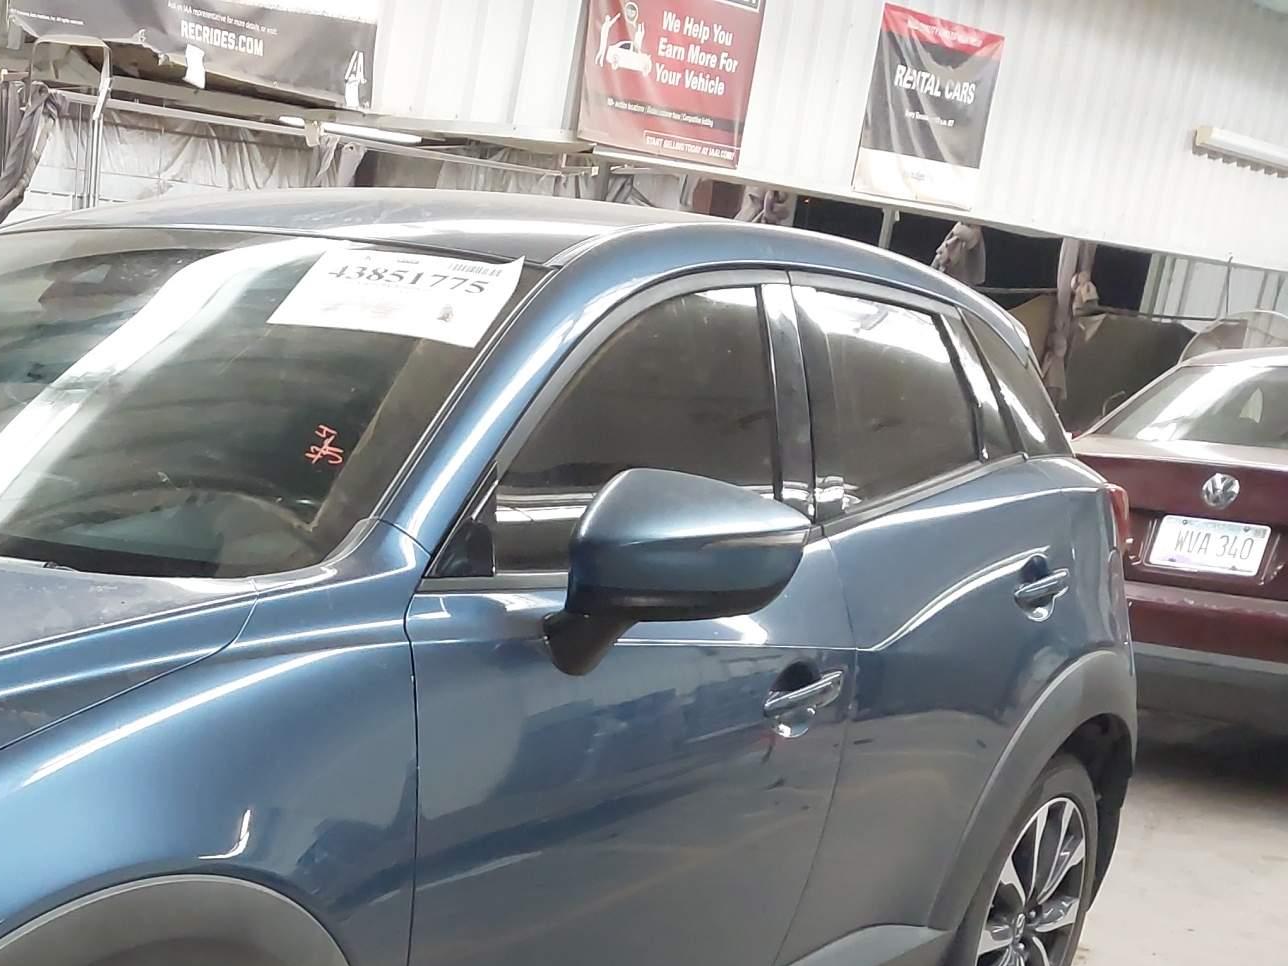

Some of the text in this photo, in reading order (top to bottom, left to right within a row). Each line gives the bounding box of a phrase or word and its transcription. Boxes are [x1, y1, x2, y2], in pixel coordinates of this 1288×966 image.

[181, 20, 263, 56] RECRIDES.COM
[662, 10, 733, 46] We Help You
[658, 37, 738, 72] Earn More For
[655, 62, 725, 96] Your Vehicle
[894, 64, 976, 104] RENTAL CARS
[328, 264, 489, 294] 43851775
[1215, 534, 1255, 560] 340
